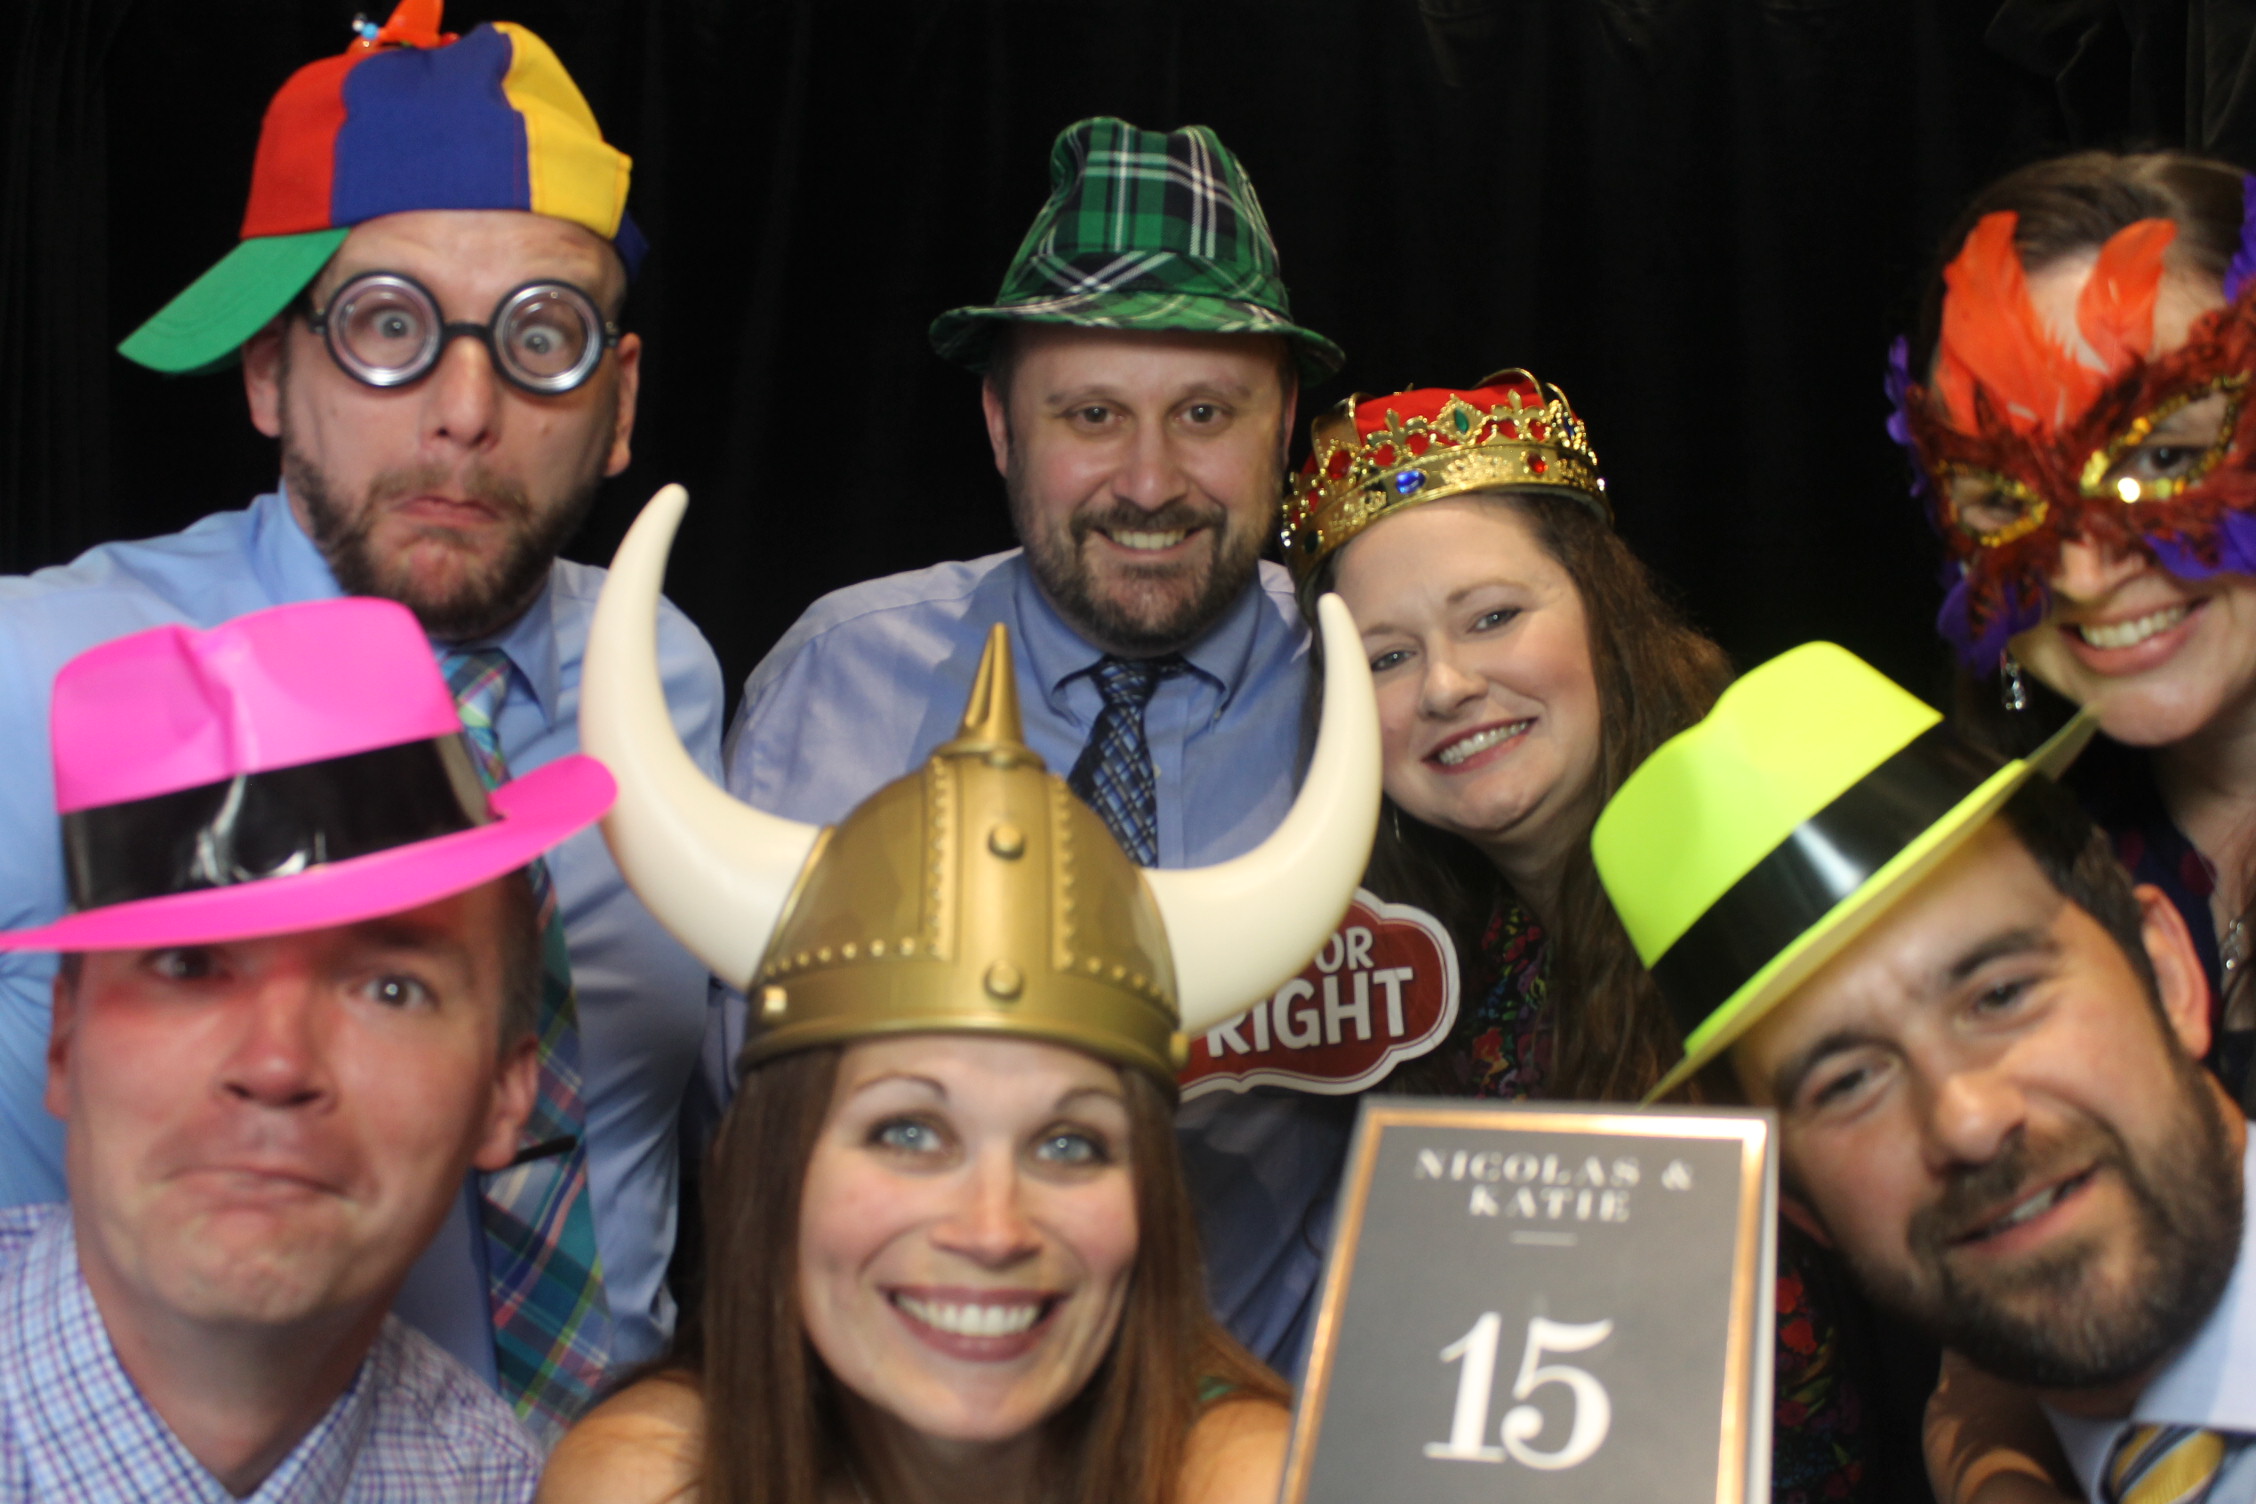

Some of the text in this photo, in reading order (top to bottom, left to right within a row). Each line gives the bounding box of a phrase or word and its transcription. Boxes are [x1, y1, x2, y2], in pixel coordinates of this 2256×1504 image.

[1207, 966, 1414, 1058] RIGHT
[1414, 1148, 1693, 1191] NICOLAS &
[1469, 1184, 1630, 1223] KATIE
[1422, 1310, 1614, 1471] 15
